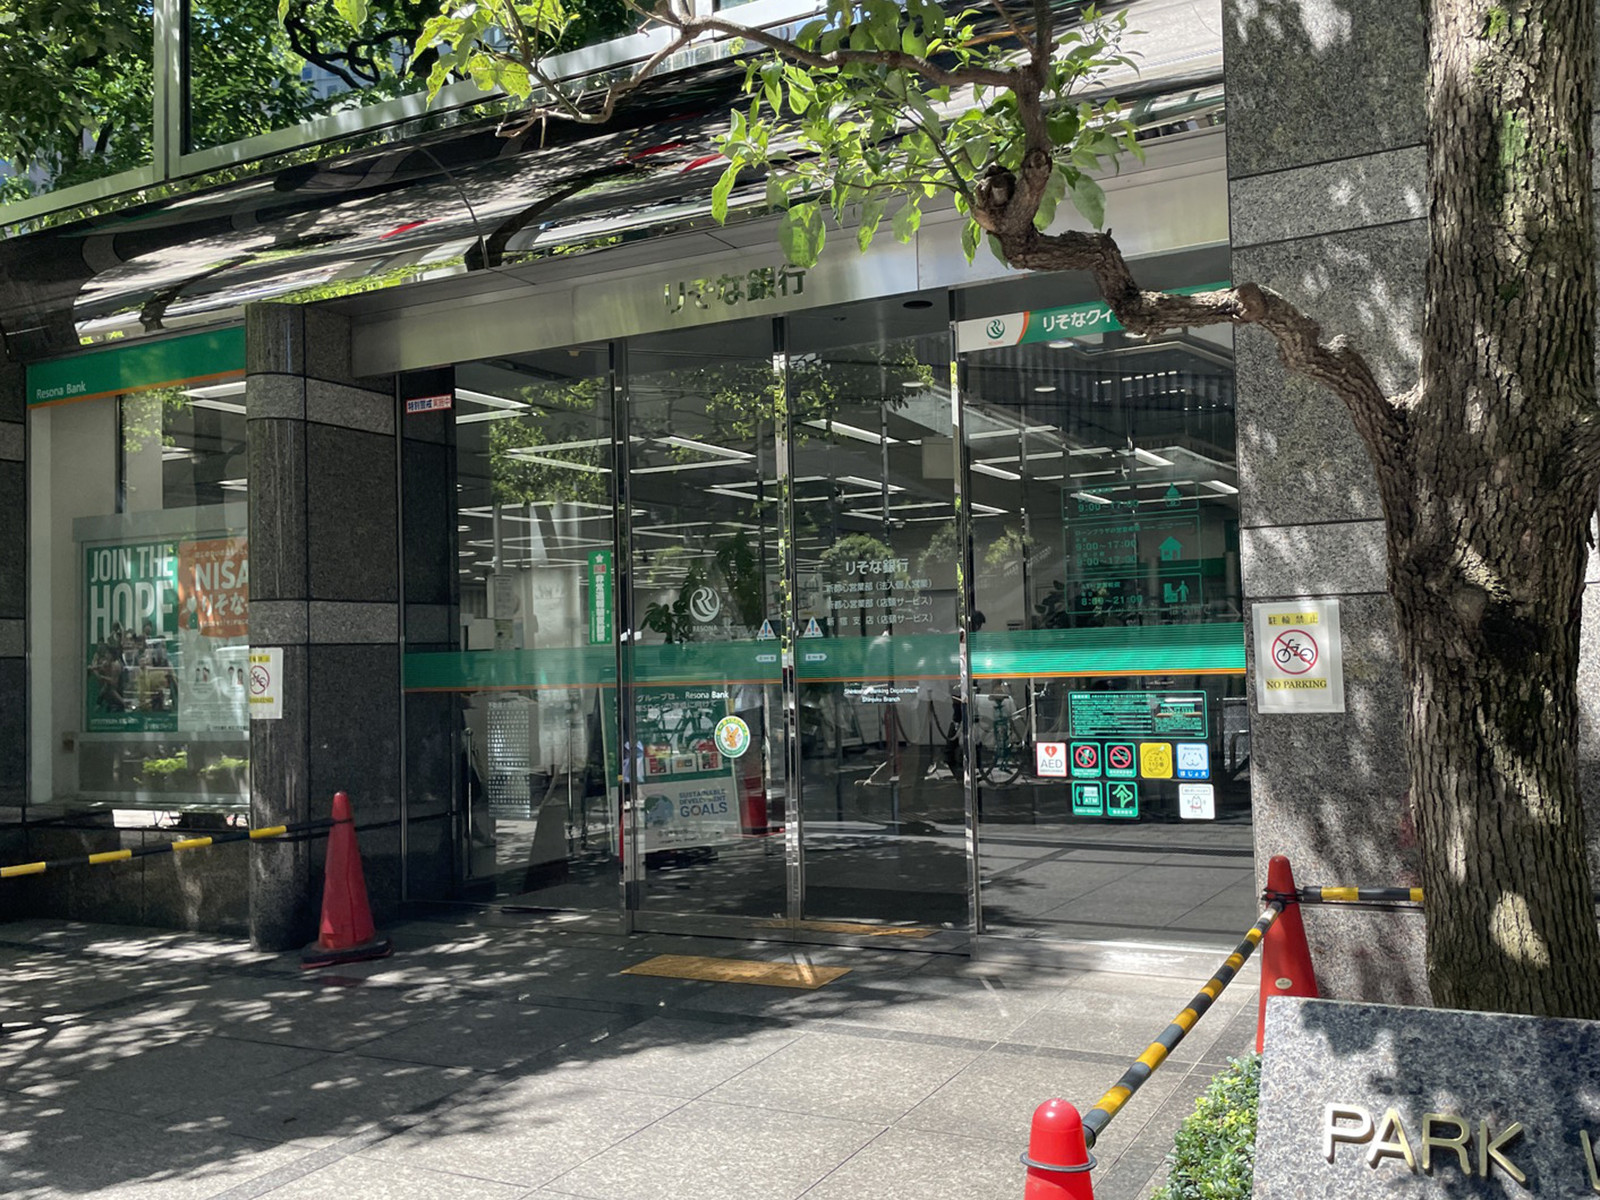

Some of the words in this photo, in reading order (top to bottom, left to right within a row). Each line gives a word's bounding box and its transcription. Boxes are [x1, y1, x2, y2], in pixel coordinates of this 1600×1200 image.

[663, 263, 807, 315] りそな銀行
[36, 386, 64, 400] Resona
[66, 381, 87, 395] Bank
[91, 547, 132, 583] JOIN
[136, 543, 174, 578] THE
[845, 558, 909, 576] りそな銀行
[195, 558, 249, 591] NISA
[90, 579, 174, 645] HOPE
[201, 592, 248, 617] りそな
[1268, 614, 1318, 625] 駐輪禁止
[1266, 680, 1281, 690] NO
[1284, 679, 1327, 689] PARKING
[685, 690, 709, 699] Resona
[711, 690, 729, 699] Bank
[1041, 759, 1063, 769] AED
[680, 801, 728, 818] GOALS
[1322, 1102, 1529, 1185] PARK
